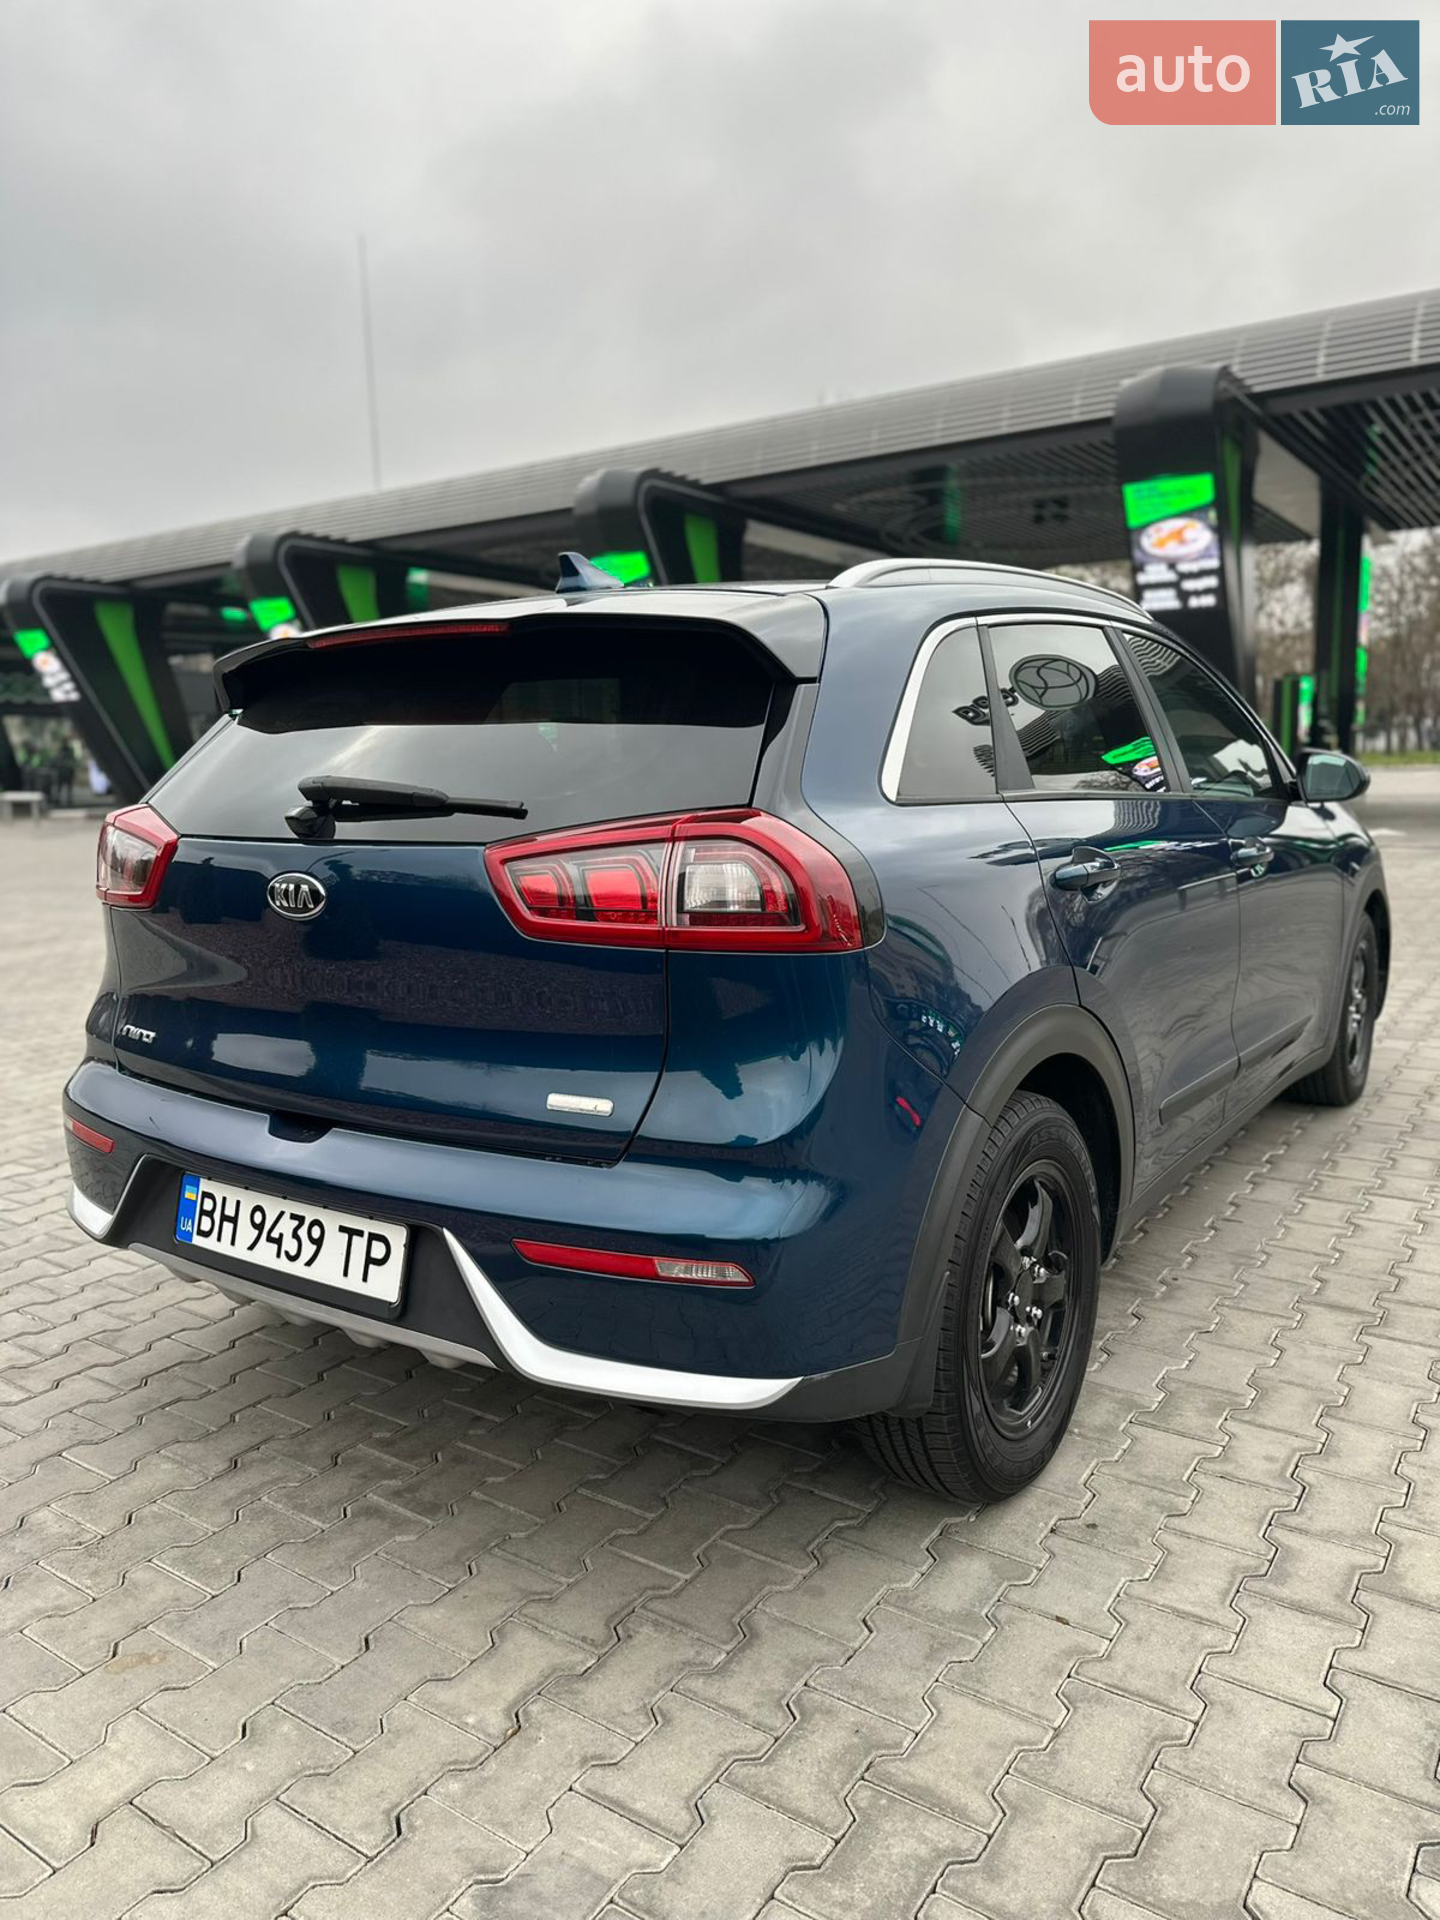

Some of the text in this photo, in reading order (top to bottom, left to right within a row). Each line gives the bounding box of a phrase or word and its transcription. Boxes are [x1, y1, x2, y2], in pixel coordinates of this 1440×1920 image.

[274, 883, 315, 909] KIA
[180, 1216, 193, 1233] UA
[196, 1190, 392, 1283] BH 9439 TP
